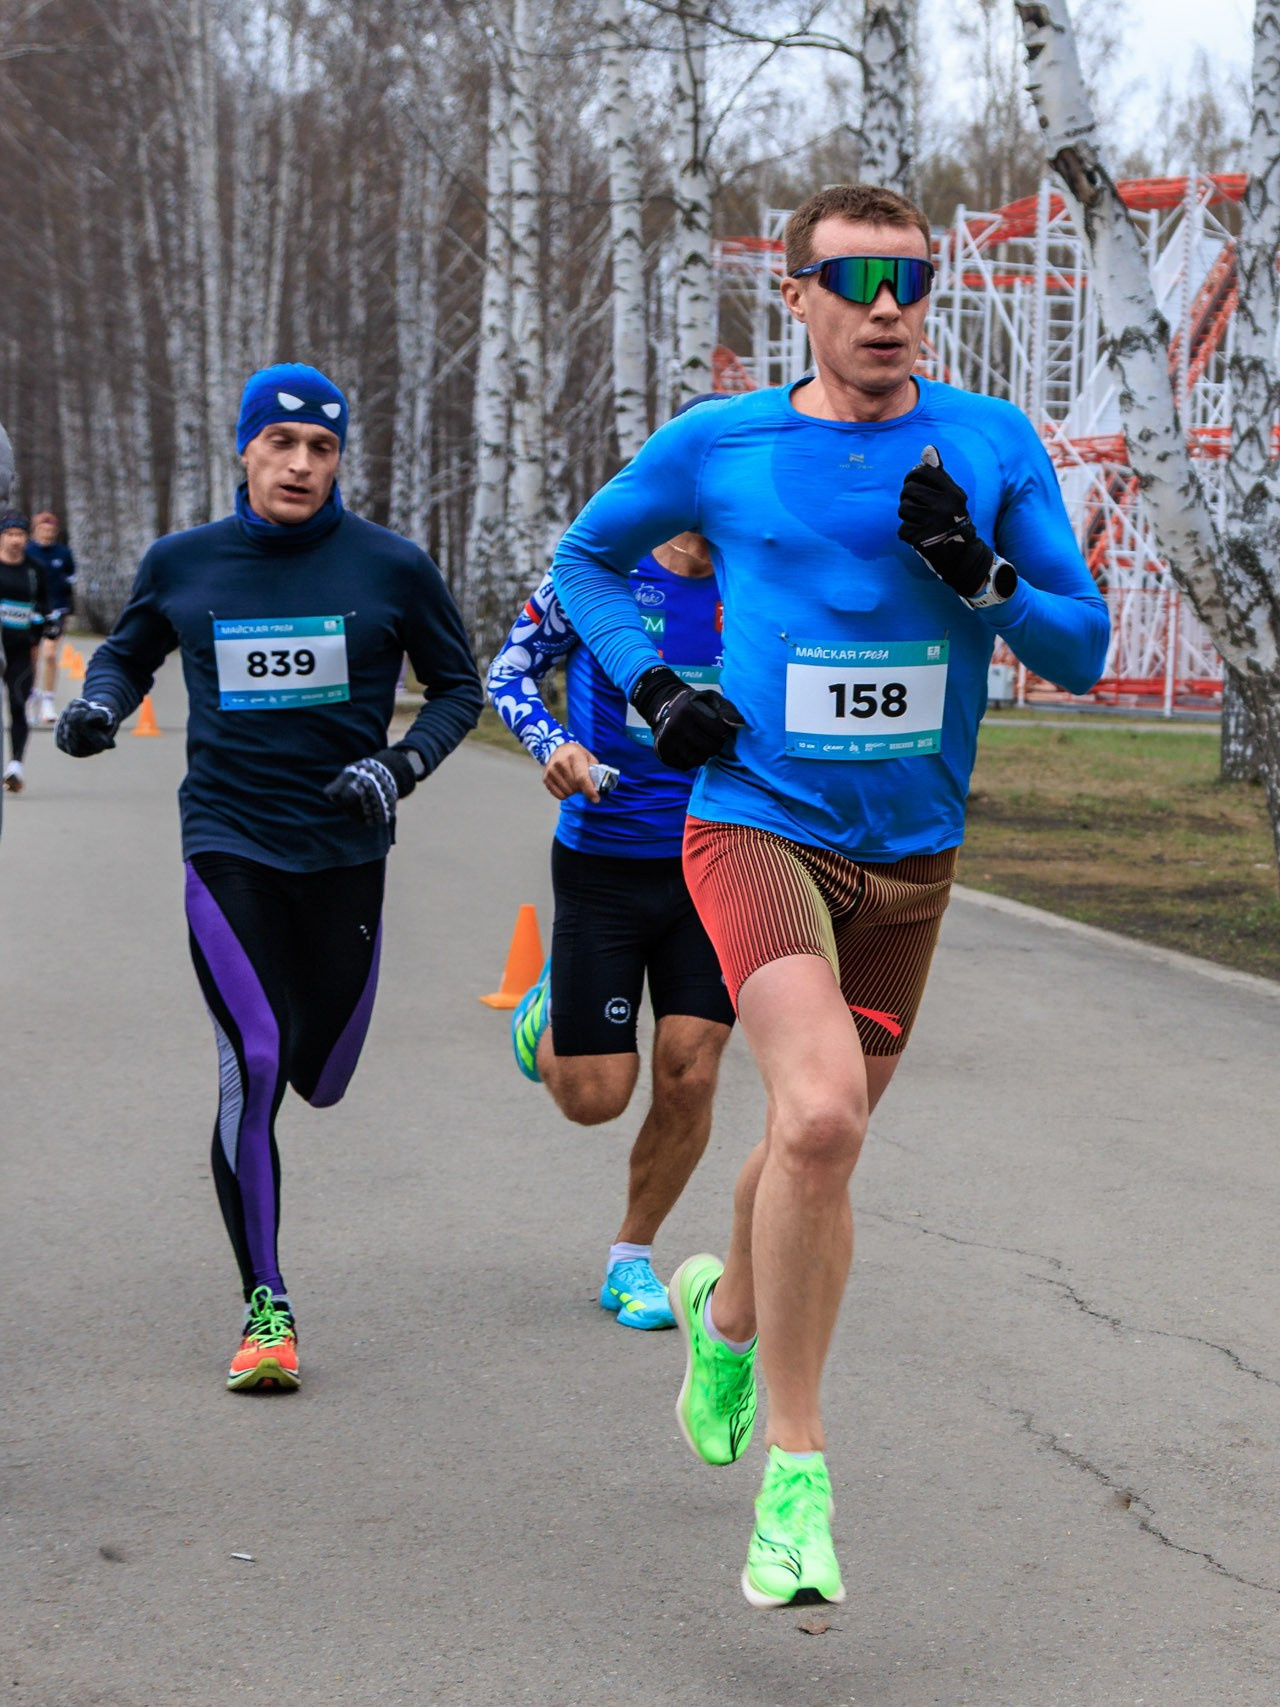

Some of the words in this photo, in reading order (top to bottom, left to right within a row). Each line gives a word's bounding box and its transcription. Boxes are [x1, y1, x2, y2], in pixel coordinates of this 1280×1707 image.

[247, 649, 316, 678] 839
[795, 647, 857, 660] МАЙСКАЯ
[828, 682, 908, 719] 158
